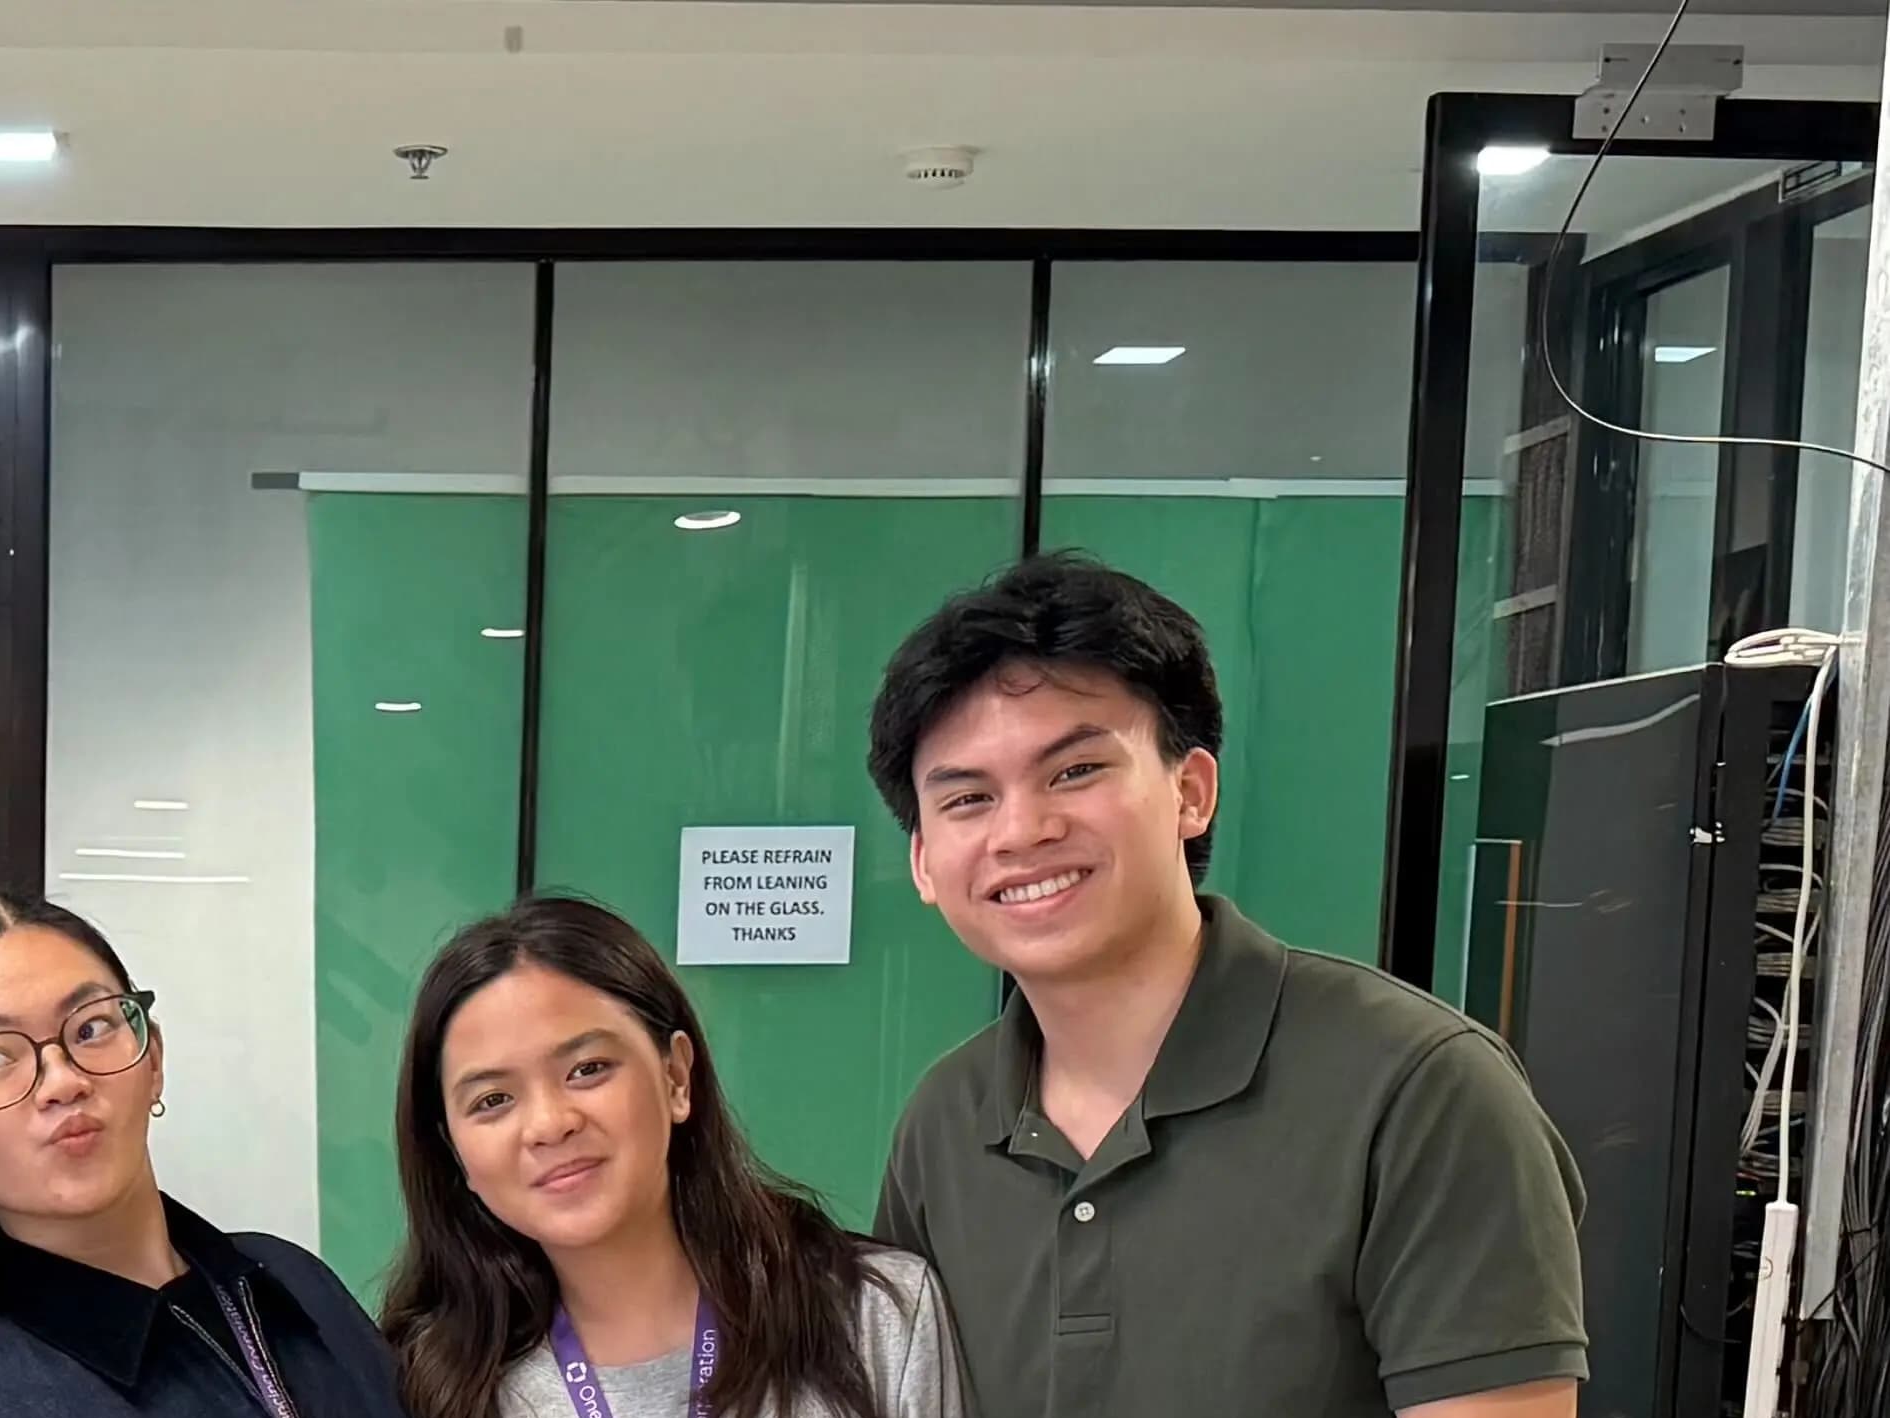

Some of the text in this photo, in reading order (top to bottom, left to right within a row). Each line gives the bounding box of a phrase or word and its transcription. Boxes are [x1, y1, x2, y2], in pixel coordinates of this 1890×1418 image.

[701, 849, 833, 865] PLEASE REFRAIN
[703, 875, 828, 890] FROM LEANING
[705, 900, 826, 916] ON THE GLASS.
[732, 926, 797, 942] THANKS
